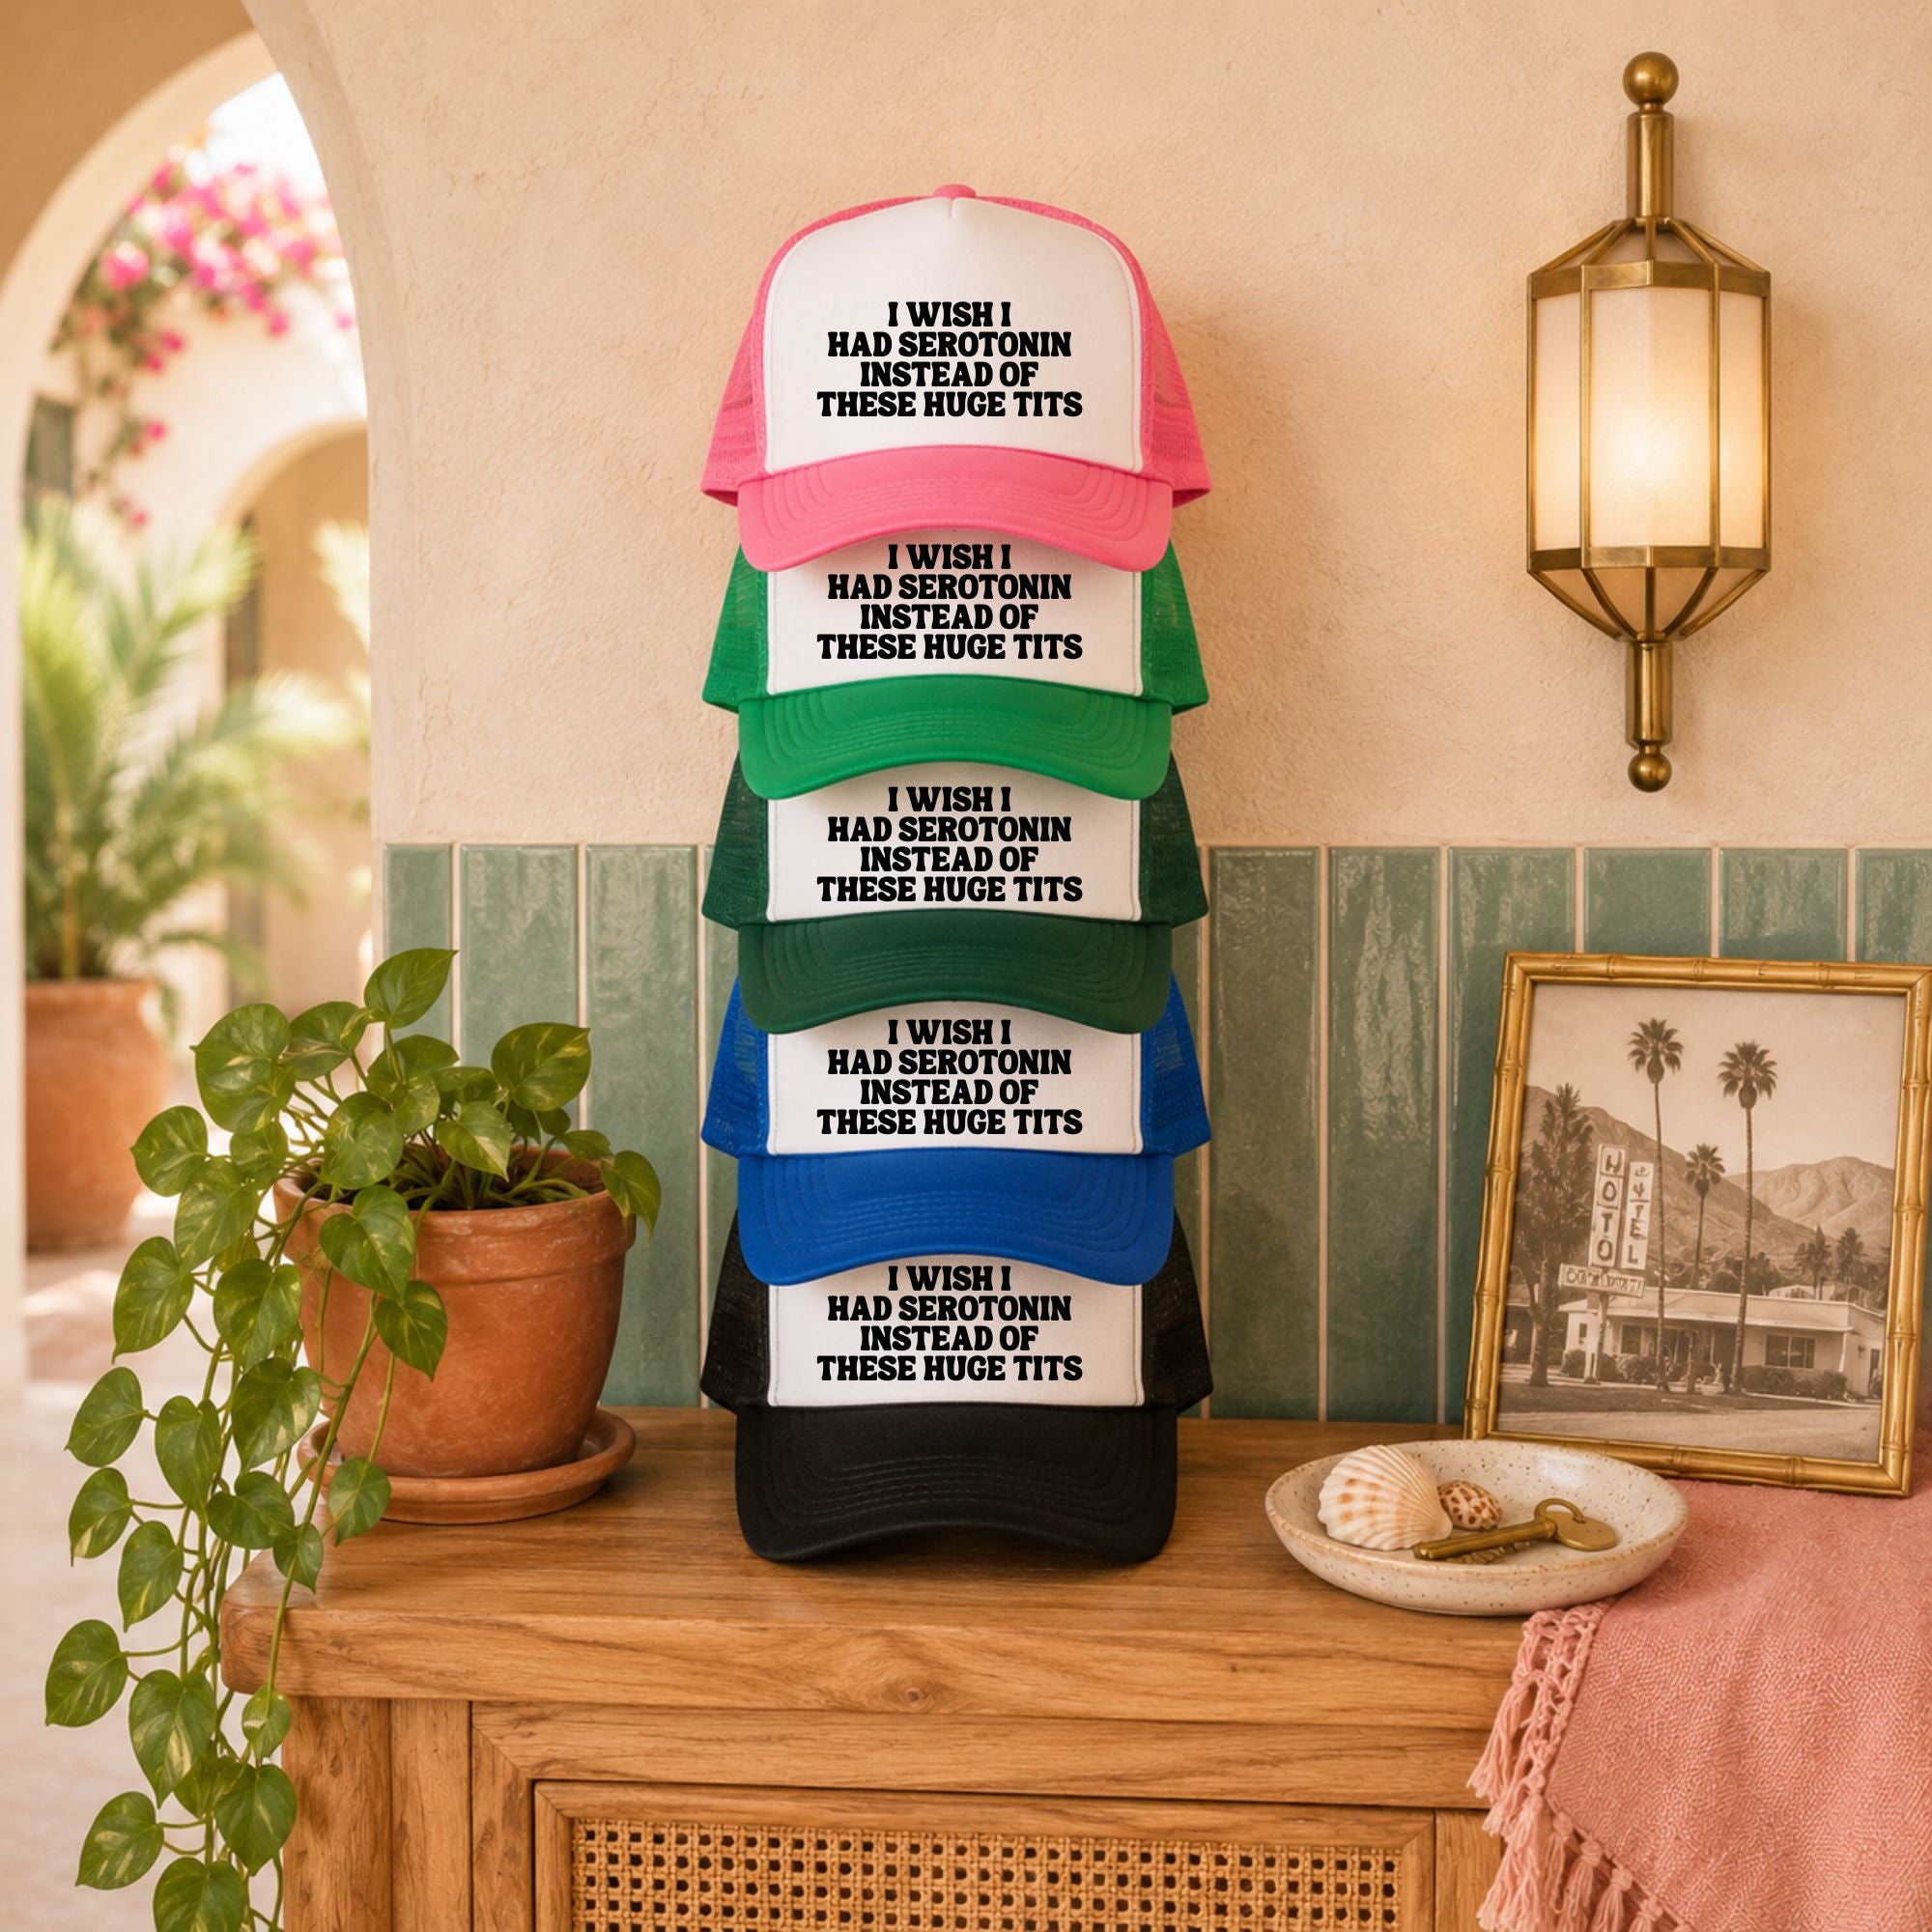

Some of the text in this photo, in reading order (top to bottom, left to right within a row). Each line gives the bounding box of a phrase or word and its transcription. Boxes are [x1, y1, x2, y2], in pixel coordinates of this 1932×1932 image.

[887, 300, 1011, 327] I WISH I
[827, 330, 1072, 357] HAD SEROTONIN
[860, 360, 1040, 387] INSTEAD OF
[816, 390, 1083, 417] THESE HUGE TITS
[887, 543, 1011, 570] I WISH I
[827, 573, 1072, 600] HAD SEROTONIN
[860, 603, 1040, 630] INSTEAD OF
[816, 633, 1083, 660] THESE HUGE TITS
[887, 785, 1011, 812] I WISH I
[827, 815, 1072, 842] HAD SEROTONIN
[860, 845, 1040, 872] INSTEAD OF
[816, 875, 1083, 902] THESE HUGE TITS
[887, 1018, 1011, 1045] I WISH I
[827, 1048, 1072, 1075] HAD SEROTONIN
[860, 1078, 1040, 1105] INSTEAD OF
[816, 1108, 1083, 1135] THESE HUGE TITS
[887, 1264, 1011, 1292] I WISH I
[827, 1294, 1072, 1321] HAD SEROTONIN
[860, 1324, 1040, 1351] INSTEAD OF
[816, 1354, 1083, 1381] THESE HUGE TITS
